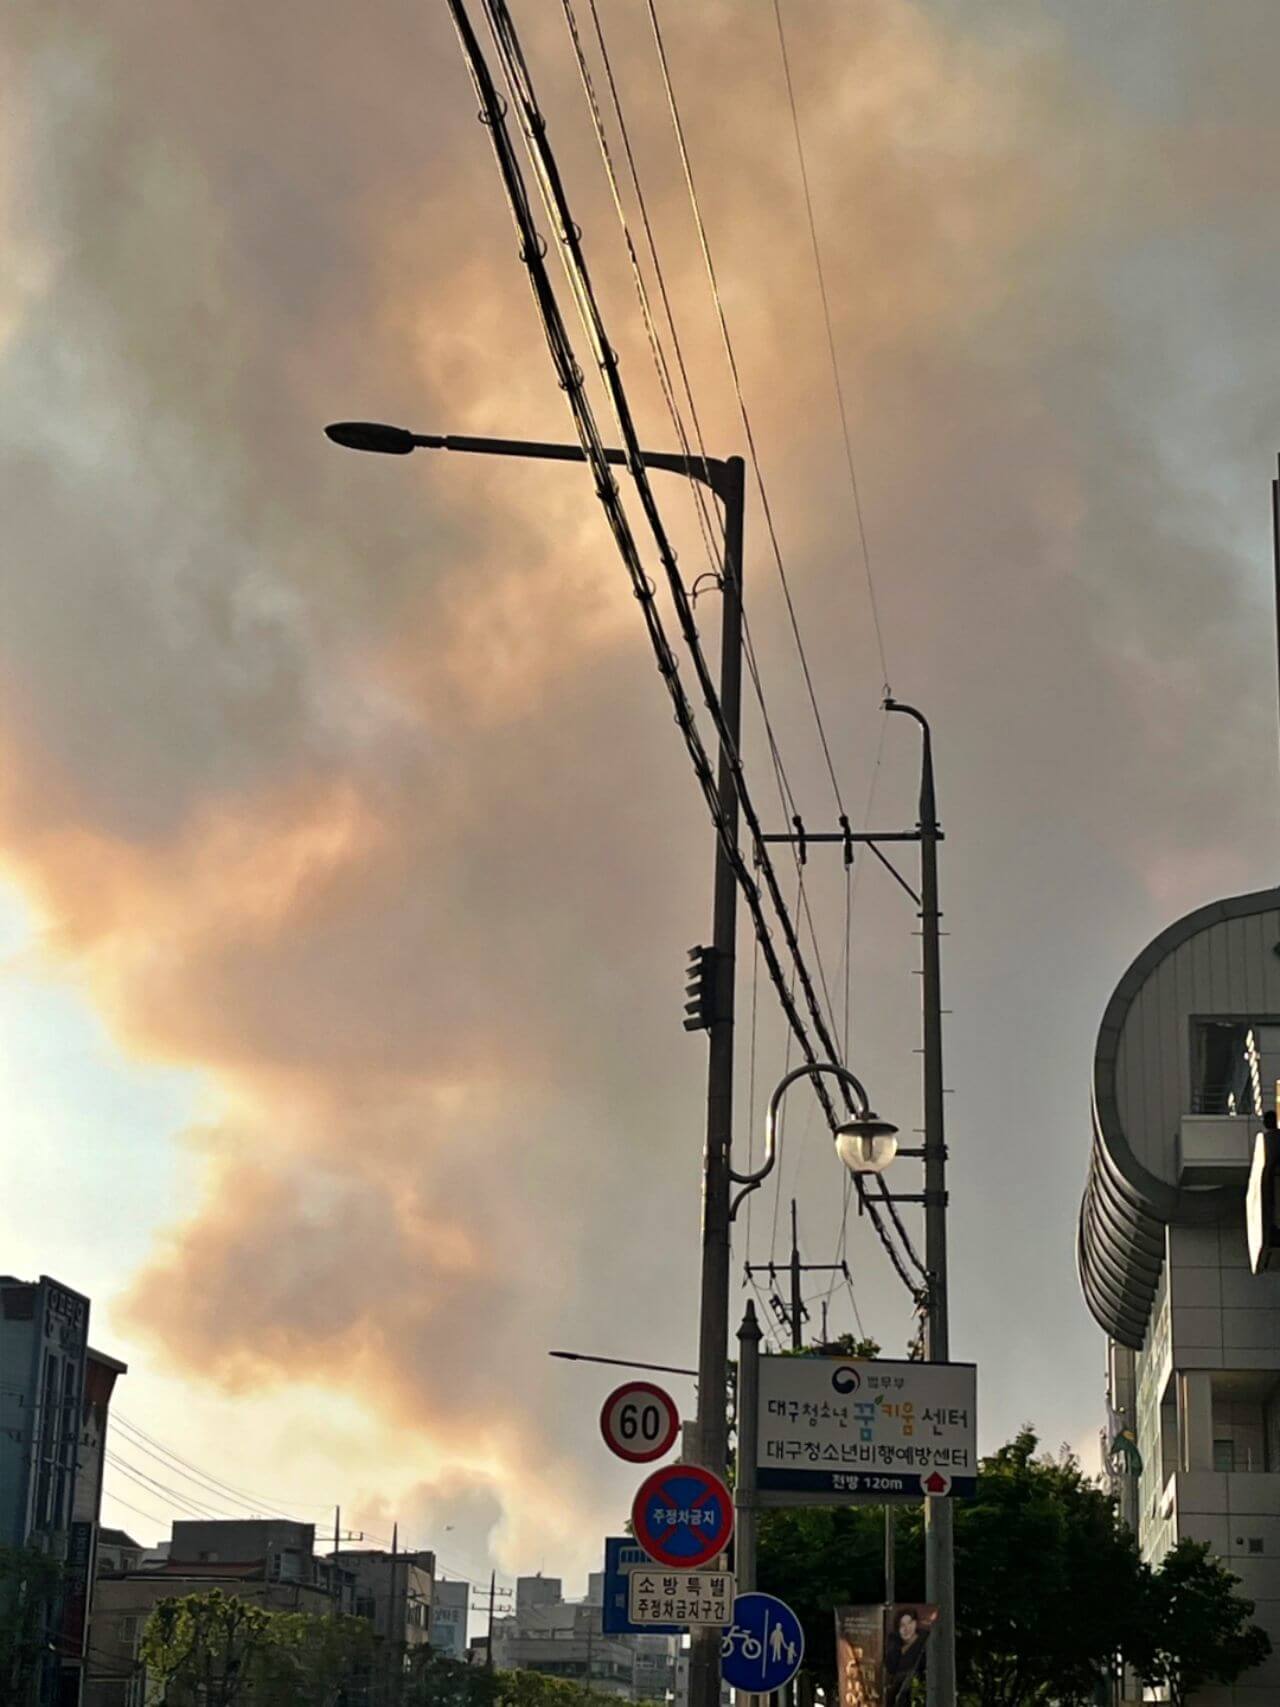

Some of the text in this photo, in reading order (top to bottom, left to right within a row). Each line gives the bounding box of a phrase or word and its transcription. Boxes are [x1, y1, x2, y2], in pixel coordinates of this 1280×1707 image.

[866, 1375, 905, 1390] 법무부
[619, 1404, 660, 1440] 60
[767, 1399, 968, 1442] 대구청소년 꿈키움 센터
[766, 1440, 968, 1467] 대구청소년비행예방센터
[832, 1473, 903, 1490] 전방 120m
[653, 1507, 714, 1526] 주정차금지
[637, 1598, 726, 1620] 주정차금지구간
